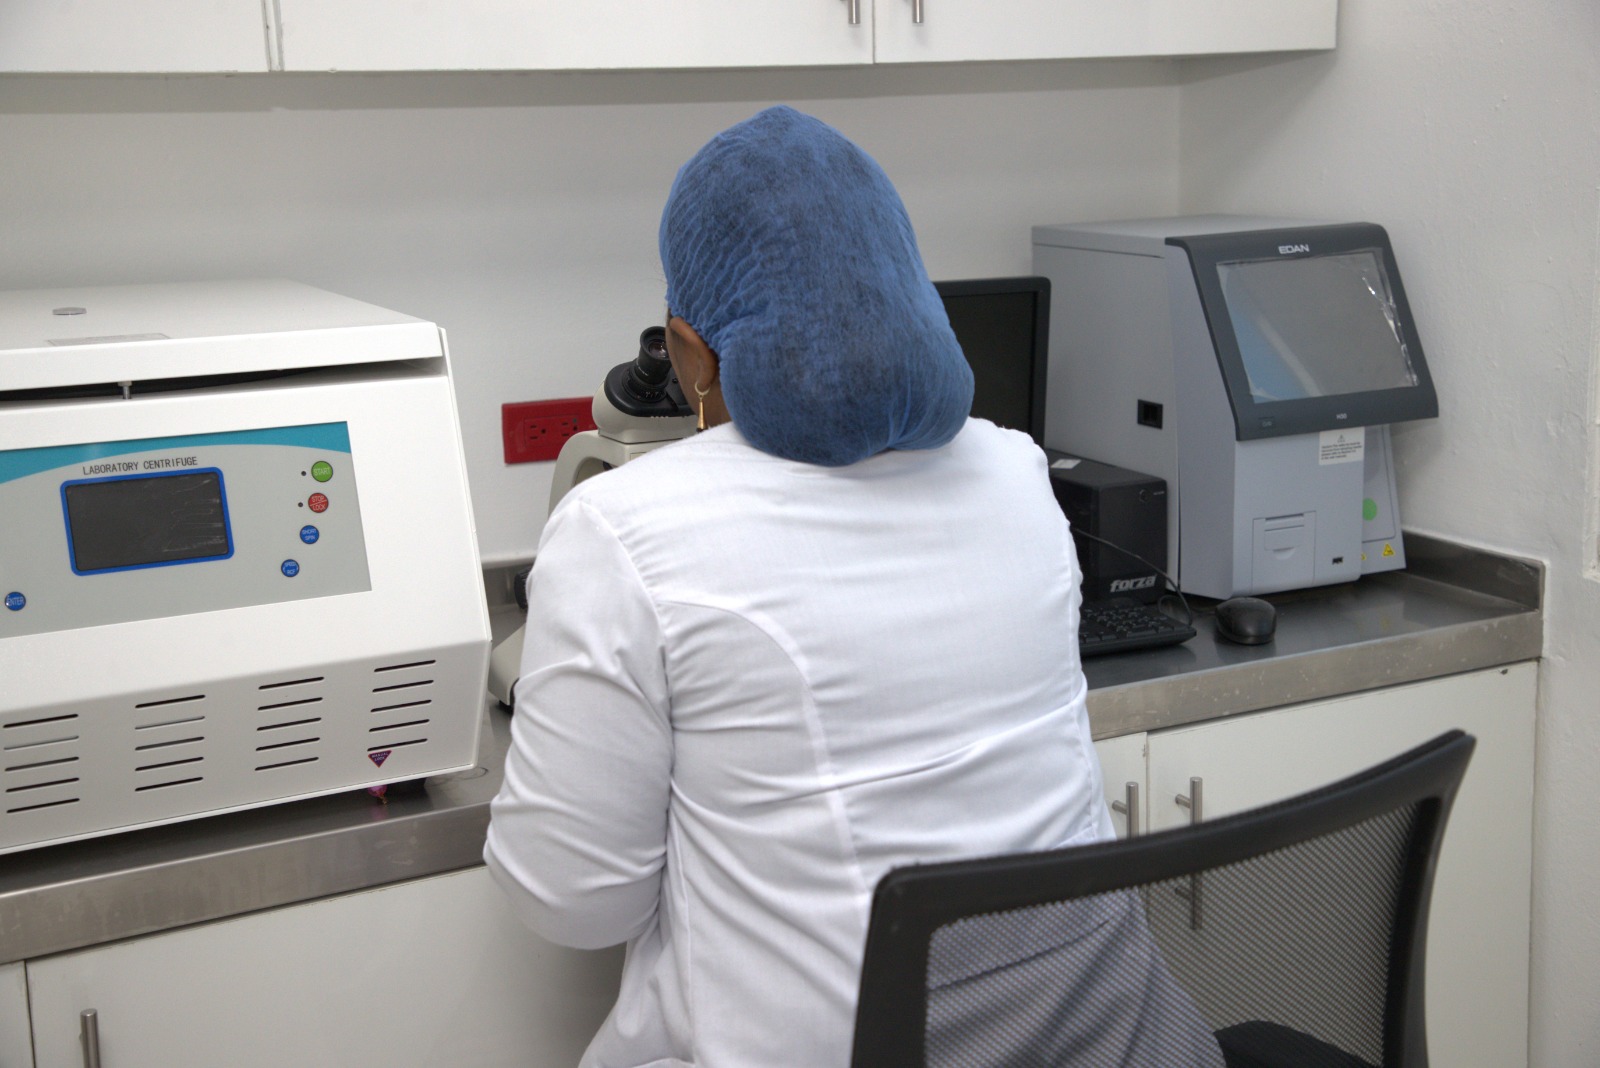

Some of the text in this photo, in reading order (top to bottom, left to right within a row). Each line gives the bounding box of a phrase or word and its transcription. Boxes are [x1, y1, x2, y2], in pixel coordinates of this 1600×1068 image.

[1278, 244, 1310, 255] EDAN
[83, 456, 198, 476] LABORATORY CENTRIFUGE
[313, 467, 331, 476] START
[312, 495, 325, 503] STOP
[1110, 574, 1158, 593] forza
[5, 596, 24, 607] ENTER
